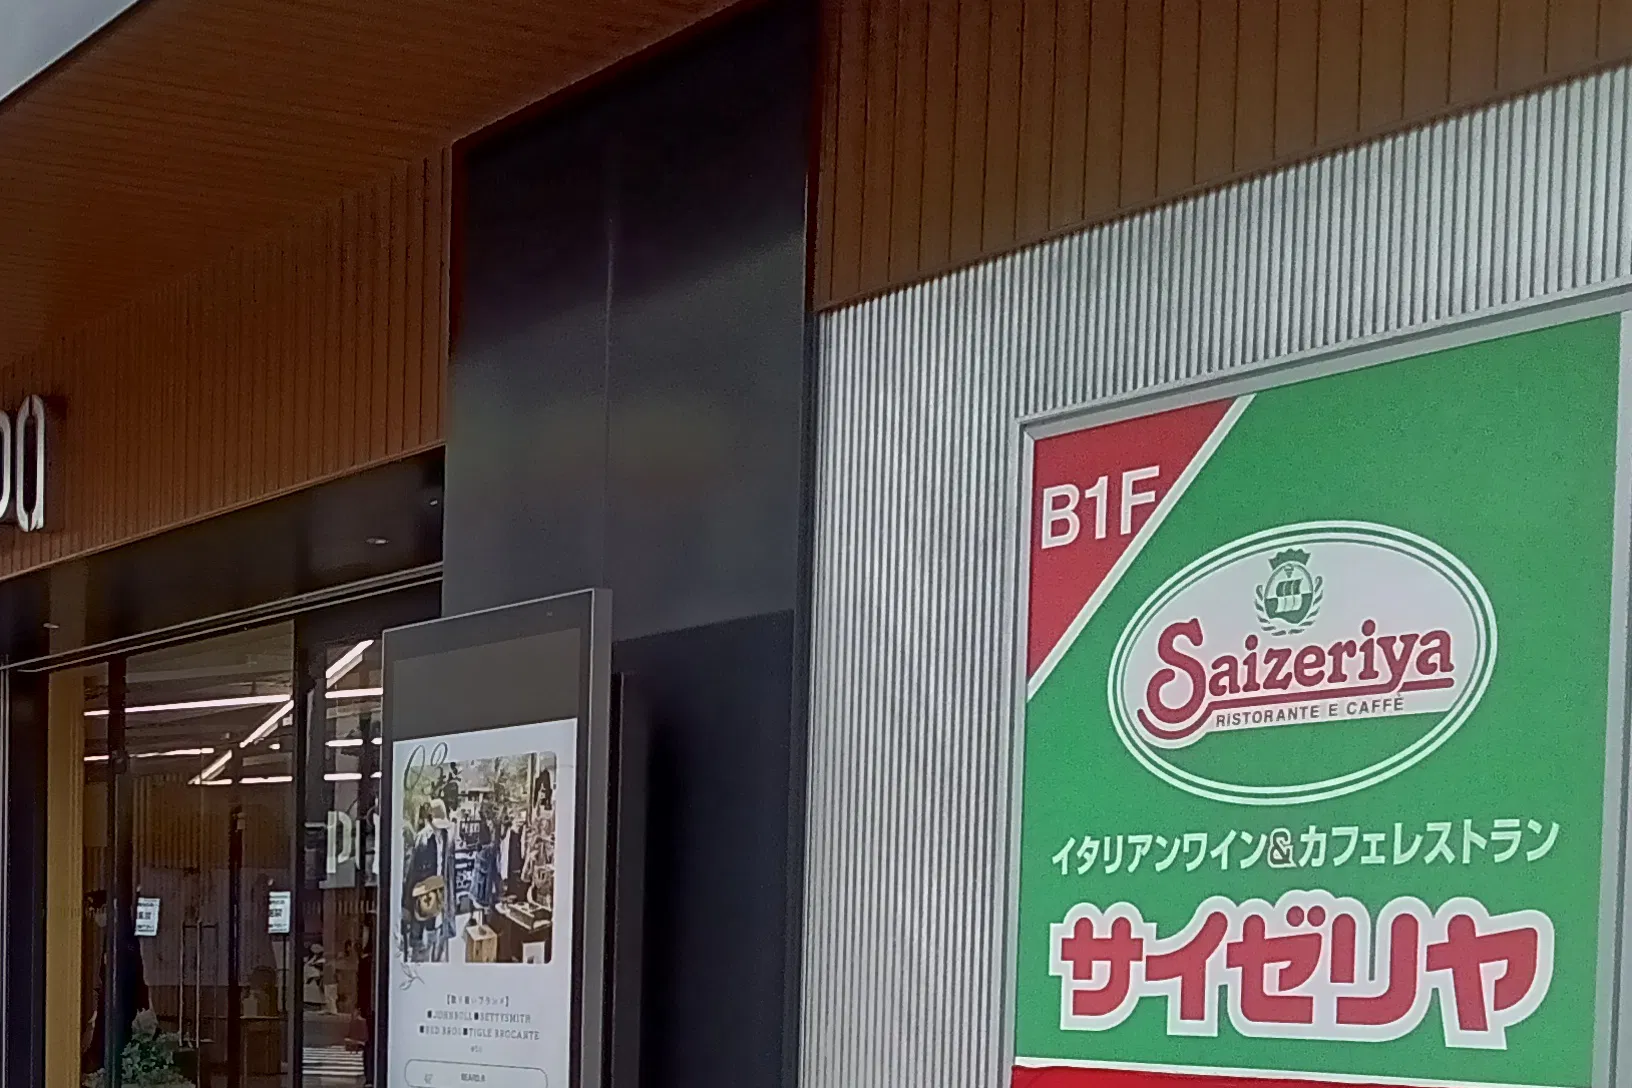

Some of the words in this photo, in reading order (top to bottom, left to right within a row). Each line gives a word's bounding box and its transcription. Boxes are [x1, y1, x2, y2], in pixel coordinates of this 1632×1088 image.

[1040, 465, 1161, 550] B1F
[1137, 616, 1455, 740] Saizeriya
[1328, 703, 1339, 717] E
[1051, 817, 1560, 876] イタリアンワイン&カフェレストラン
[1054, 898, 1545, 1038] サイゼリヤ
